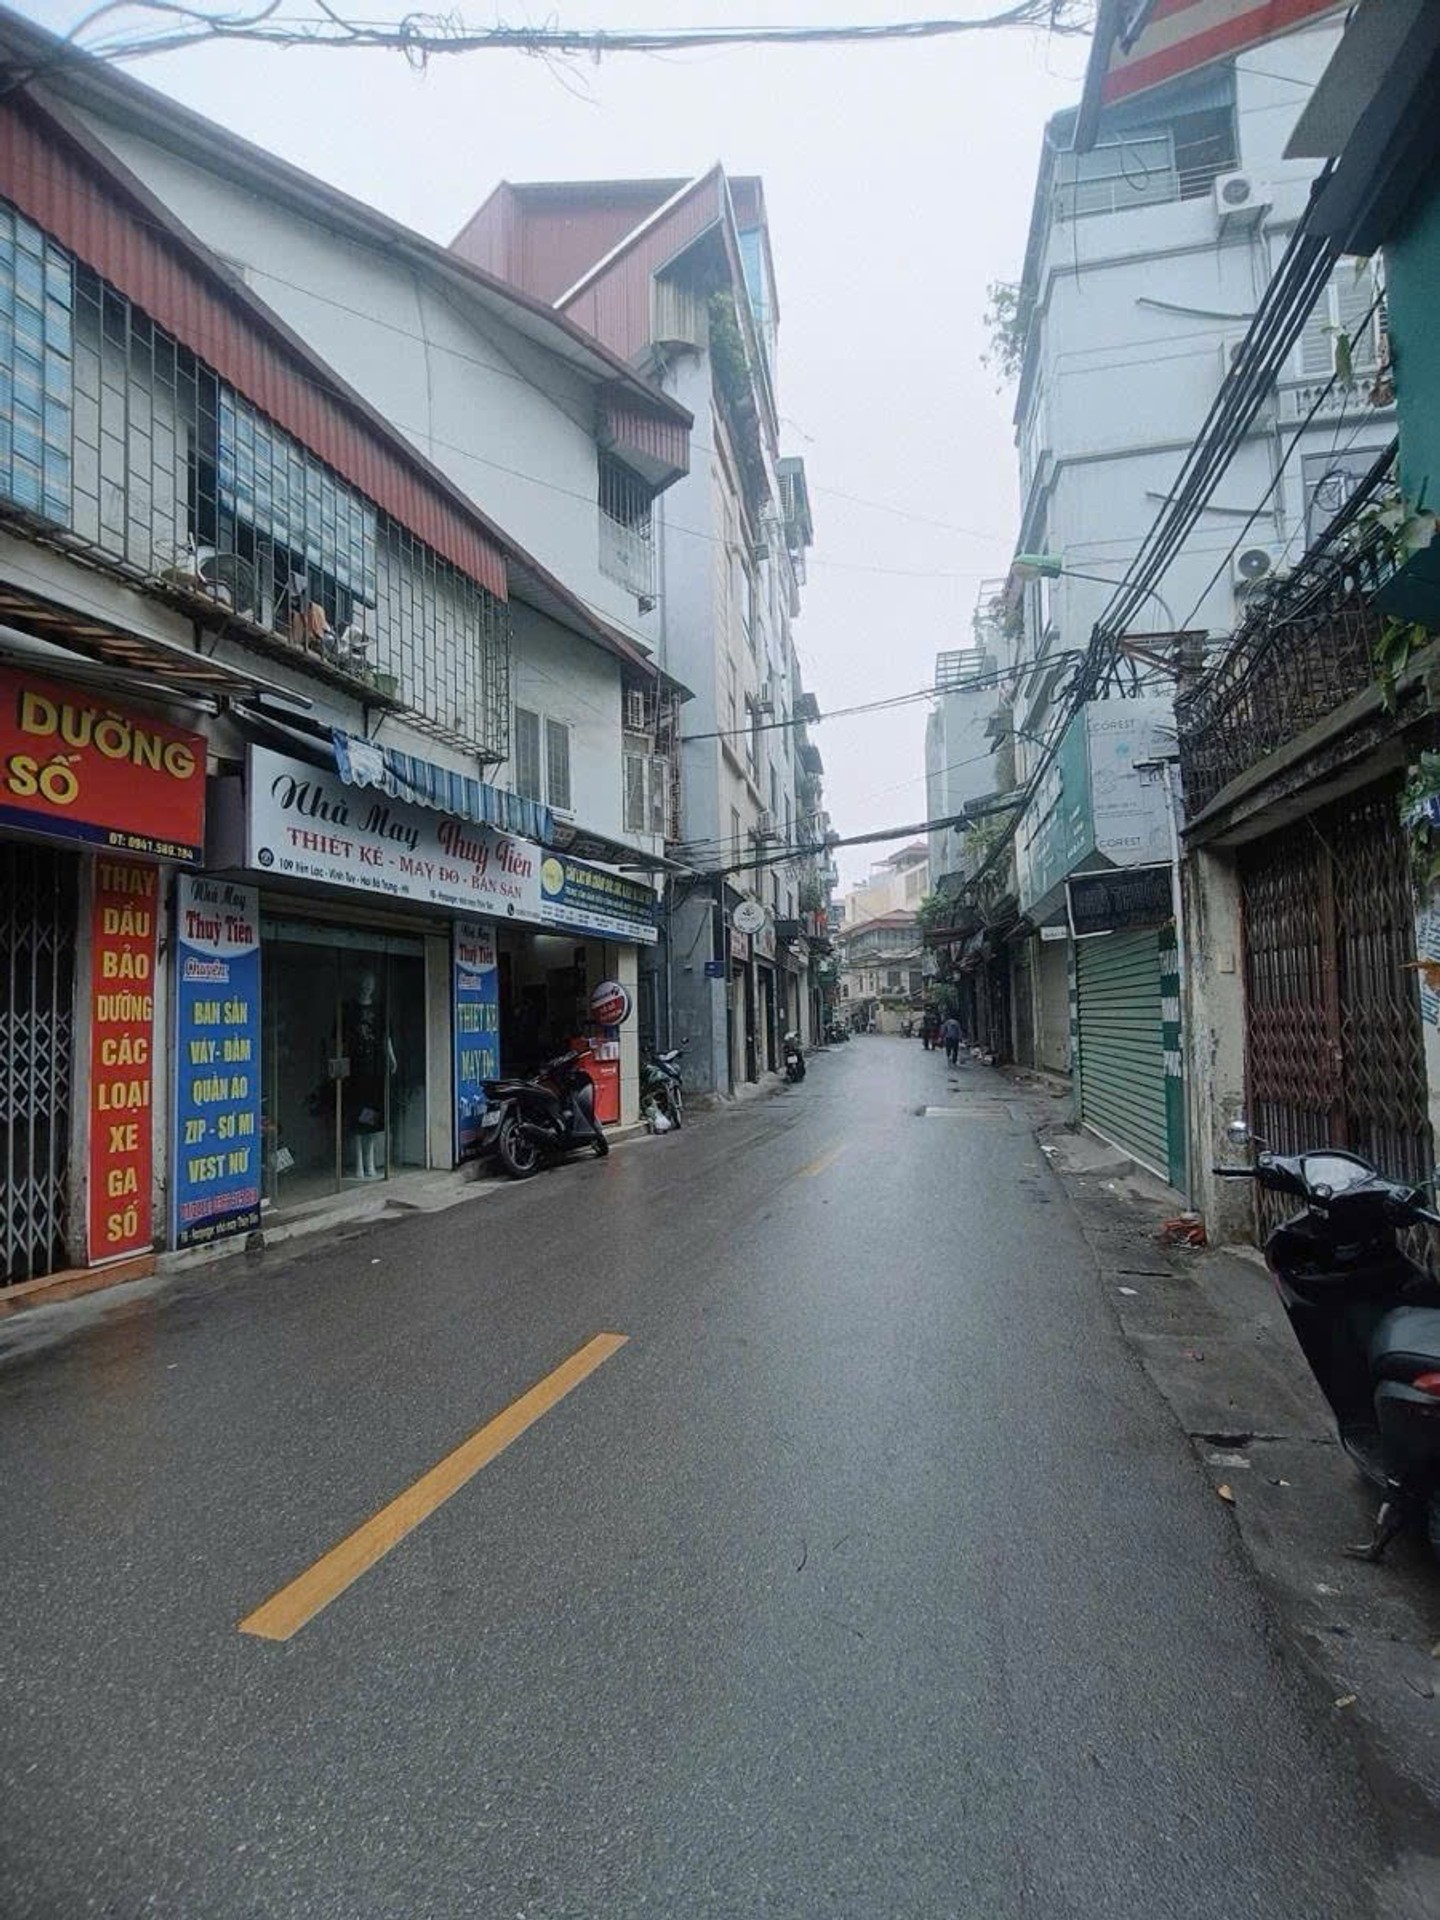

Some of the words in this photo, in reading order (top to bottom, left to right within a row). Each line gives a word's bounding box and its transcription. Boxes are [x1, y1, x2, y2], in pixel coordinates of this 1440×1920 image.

[20, 690, 197, 780] DƯỠNG
[8, 754, 82, 805] SỐ
[271, 774, 348, 827] Nhà
[358, 804, 421, 852] May
[495, 840, 533, 879] Tiên
[100, 863, 156, 897] THAY
[279, 857, 293, 870] 109
[400, 856, 435, 881] MAY
[225, 914, 253, 944] Tiên
[103, 944, 149, 980] BẢO
[97, 988, 153, 1022] DƯỠNG
[102, 1033, 148, 1066] CÁC
[98, 1081, 149, 1114] LOẠI
[109, 1124, 138, 1152] XE
[238, 1113, 254, 1136] MI
[108, 1165, 138, 1197] GA
[189, 1155, 226, 1184] VEST
[228, 1145, 251, 1176] NỮ
[107, 1202, 138, 1243] SỐ
